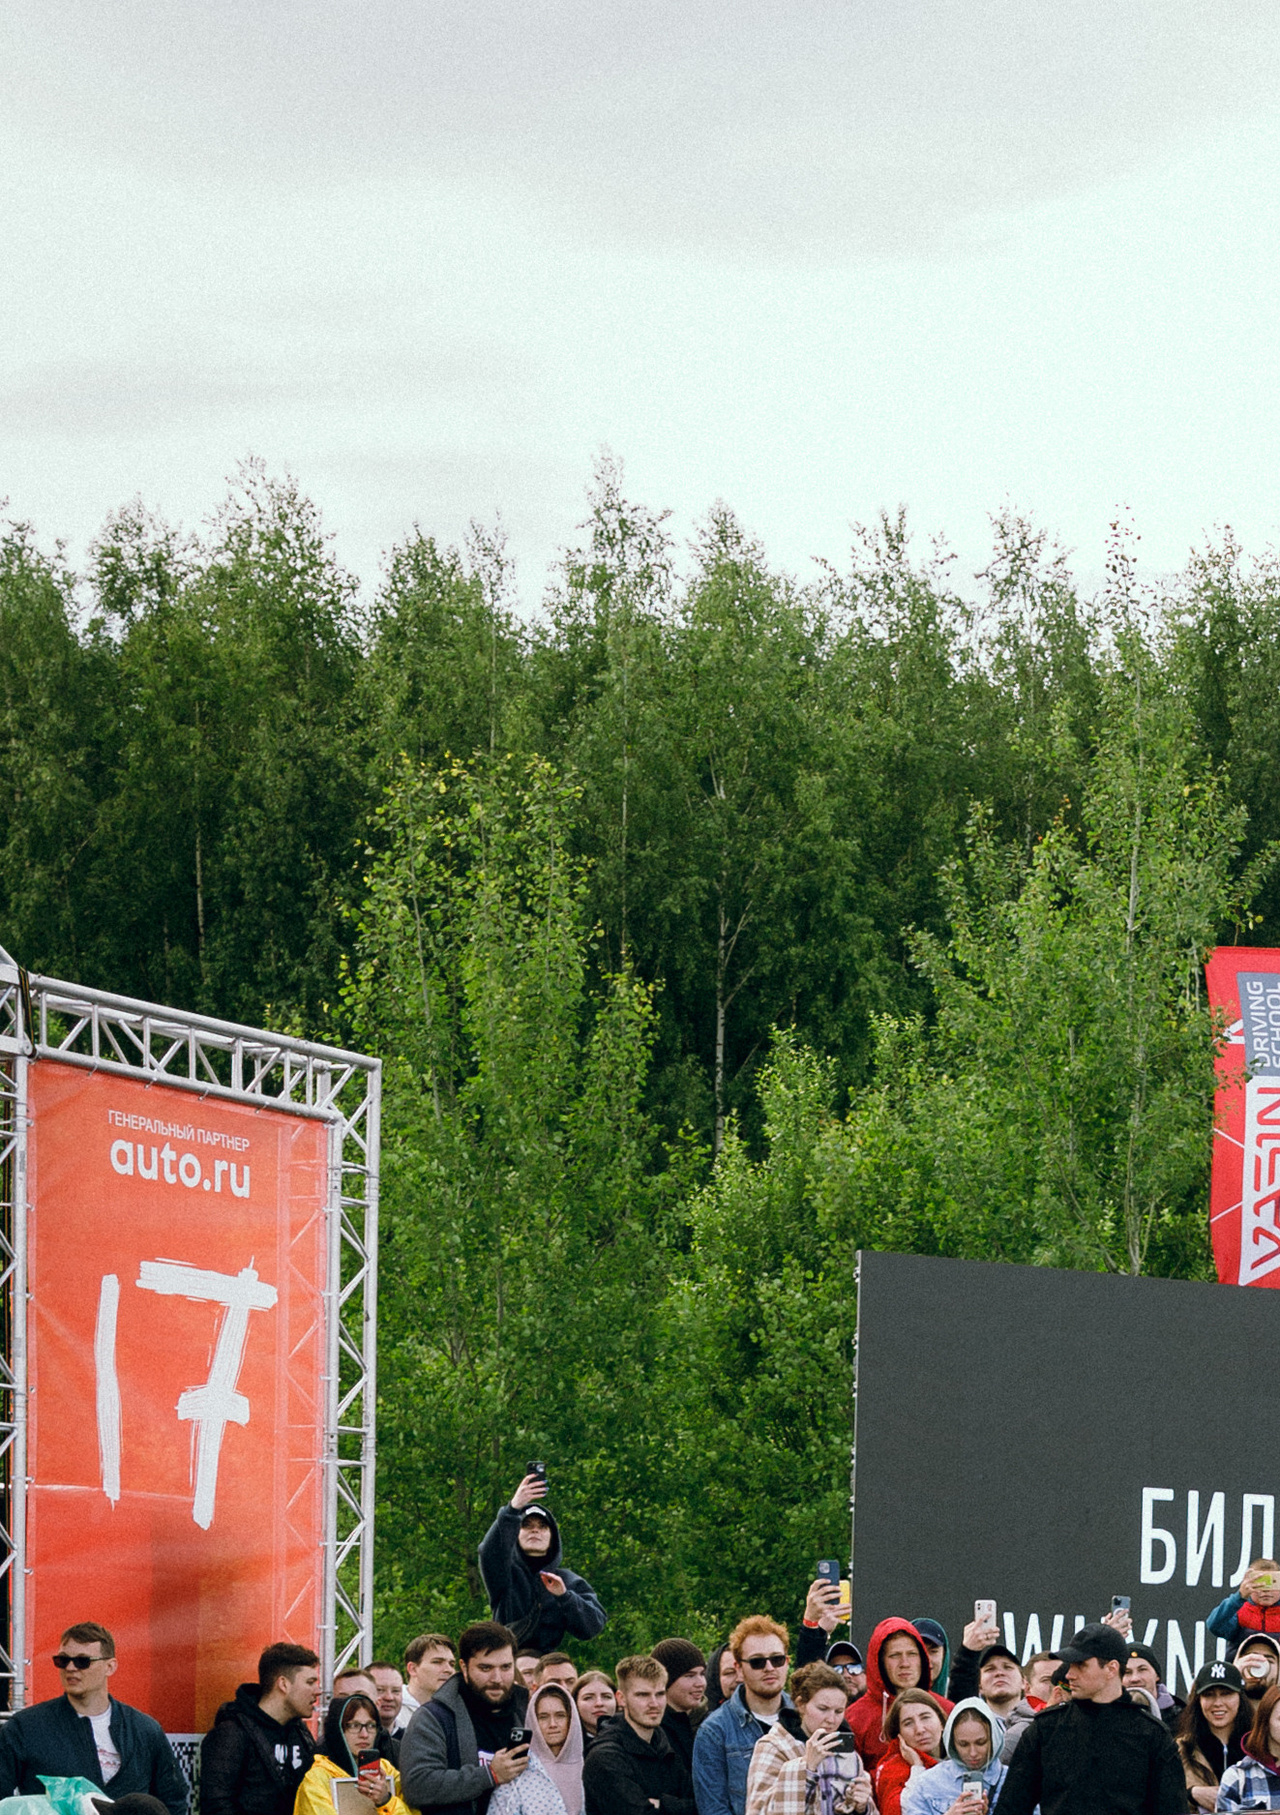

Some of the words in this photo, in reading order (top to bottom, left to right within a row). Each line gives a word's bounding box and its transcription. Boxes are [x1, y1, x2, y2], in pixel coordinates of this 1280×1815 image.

[1248, 981, 1271, 1067] DRIVING
[108, 1109, 195, 1142] ГЕНЕРАЛЬНЫЙ
[197, 1128, 250, 1152] ПАРТНЕР
[110, 1139, 250, 1198] auto.ru
[94, 1255, 278, 1531] 17
